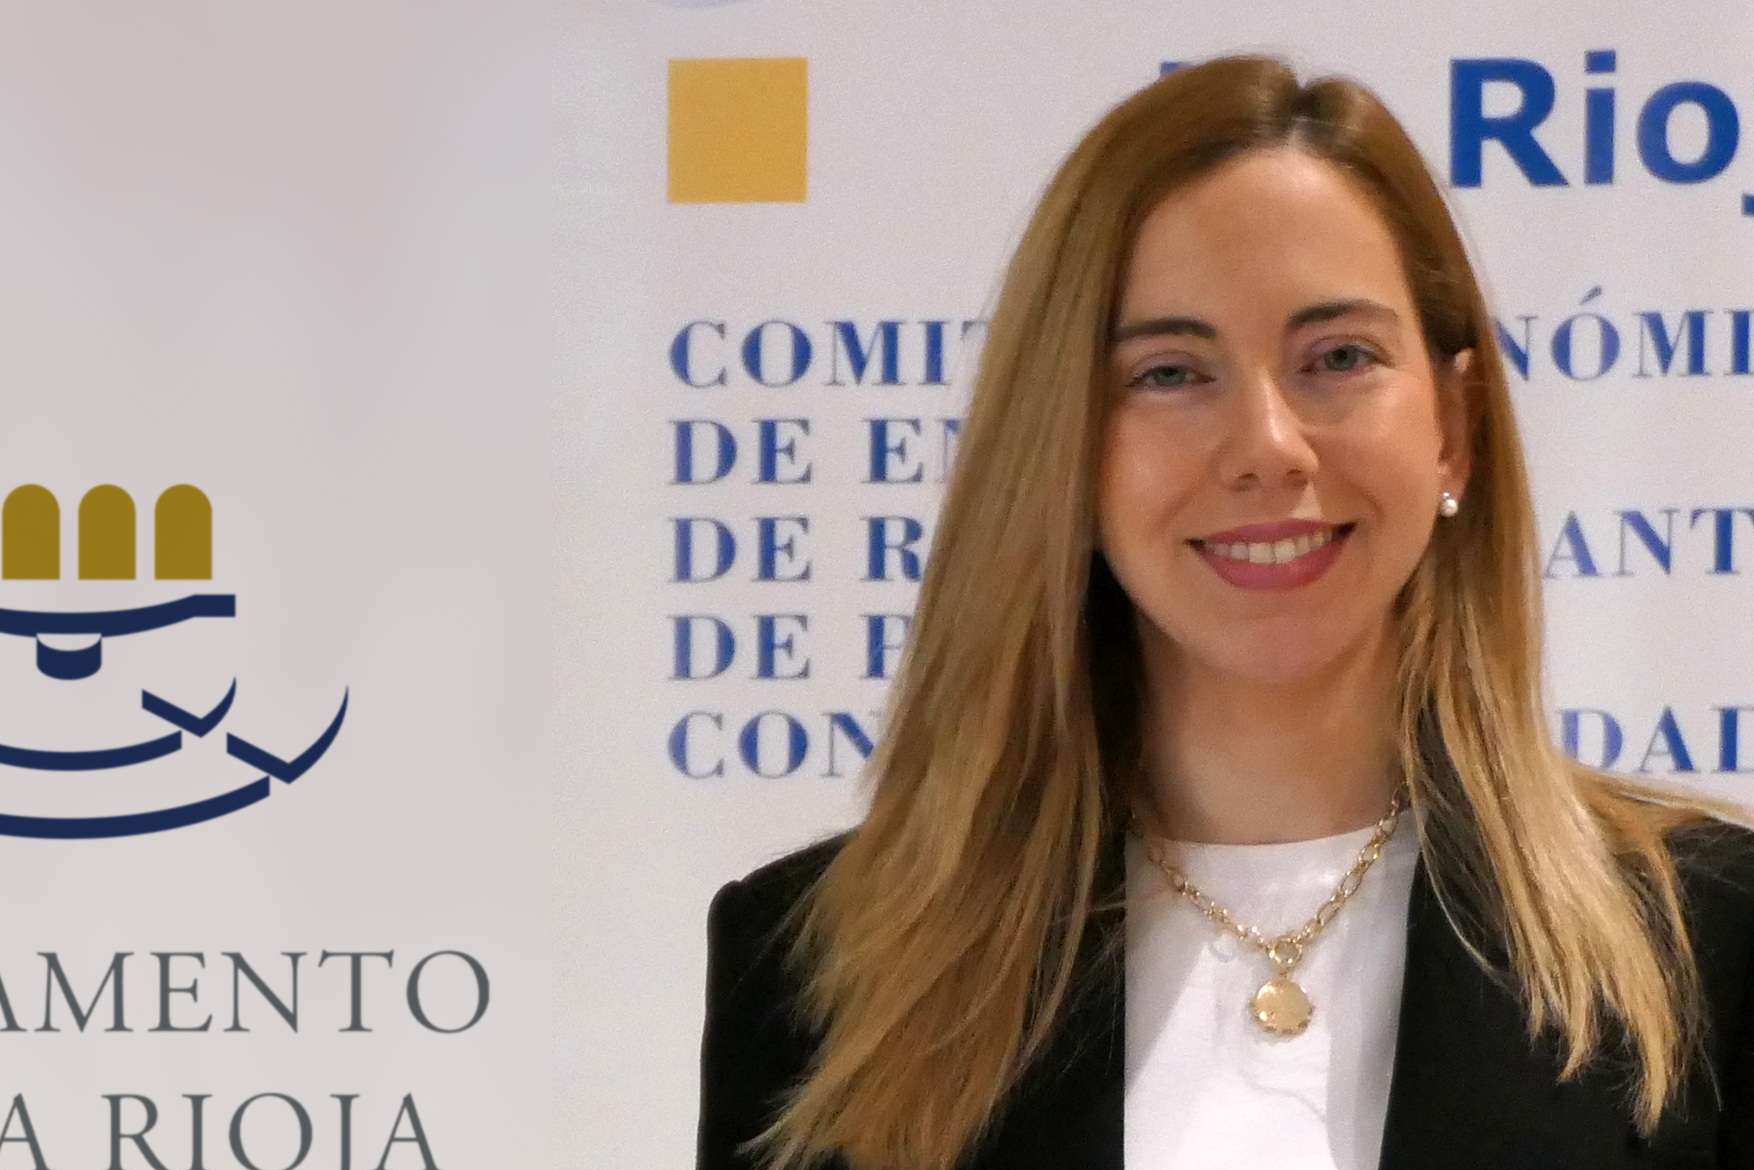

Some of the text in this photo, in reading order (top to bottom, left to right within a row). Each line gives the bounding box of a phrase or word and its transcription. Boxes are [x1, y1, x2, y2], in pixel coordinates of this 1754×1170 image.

[668, 416, 812, 487] DE
[668, 515, 812, 584] DE
[667, 612, 812, 682] DE
